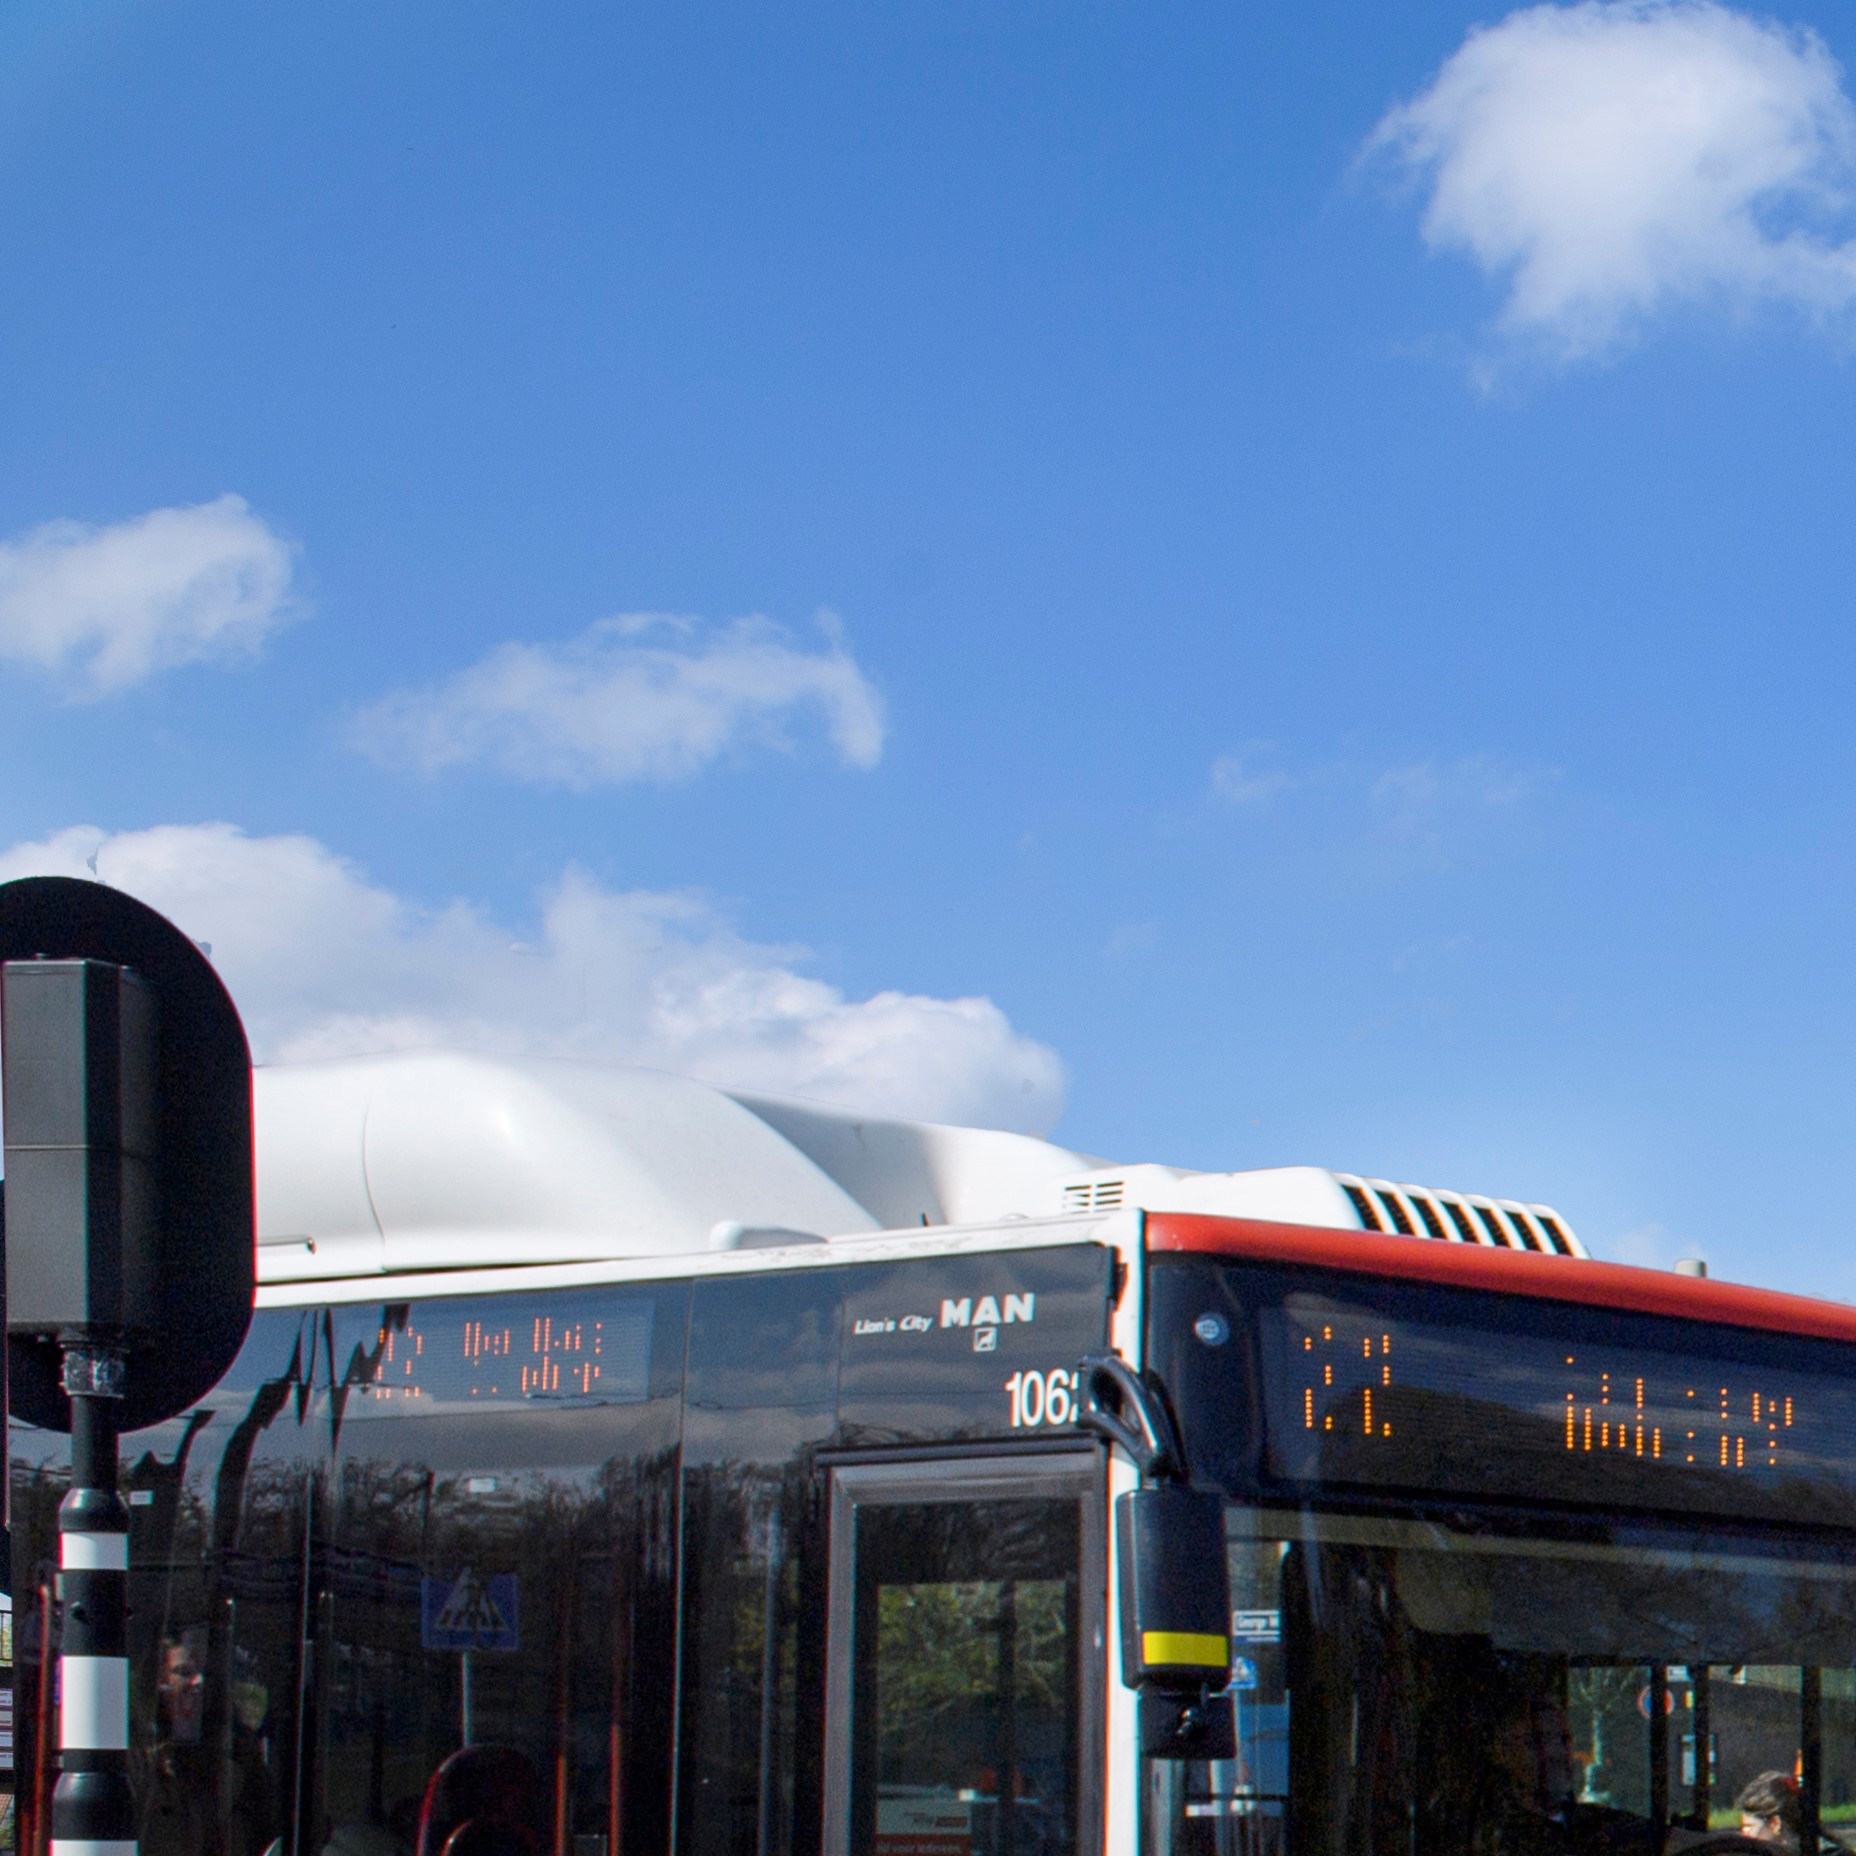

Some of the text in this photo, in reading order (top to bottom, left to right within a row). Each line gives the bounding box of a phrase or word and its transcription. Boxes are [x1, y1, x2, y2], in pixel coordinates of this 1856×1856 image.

[854, 1292, 1035, 1335] Lion's City MAN
